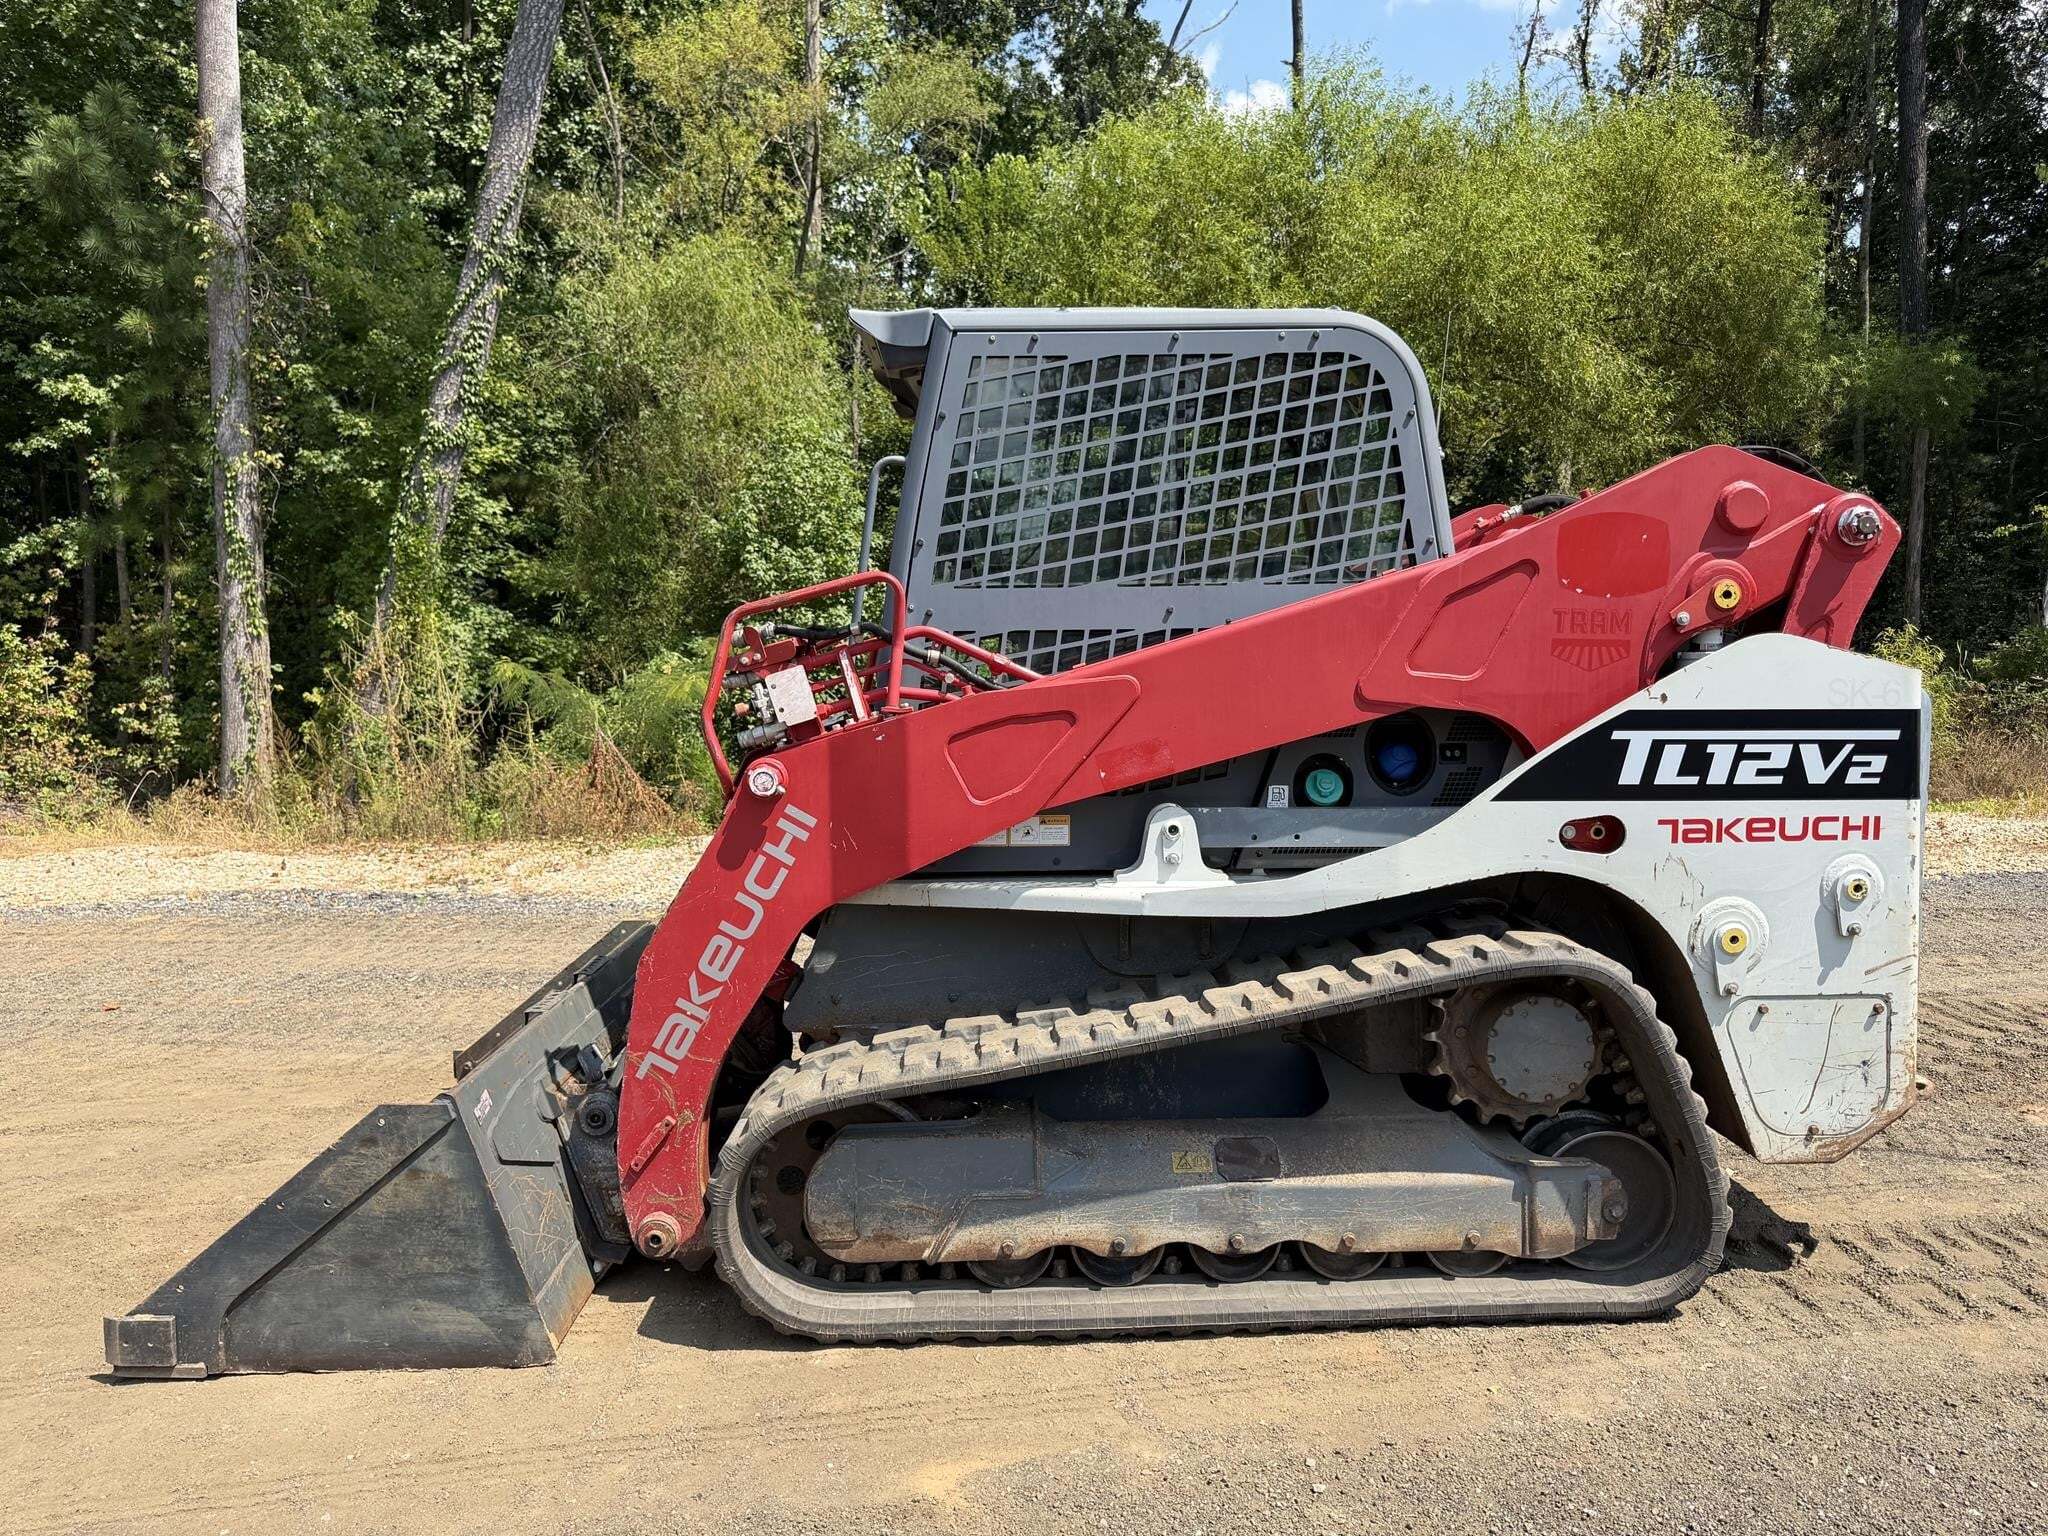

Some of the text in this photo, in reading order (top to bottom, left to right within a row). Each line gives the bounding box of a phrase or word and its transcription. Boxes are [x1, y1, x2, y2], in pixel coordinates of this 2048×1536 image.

[1552, 608, 1632, 634] TRAM
[1828, 678, 1901, 706] SK-6
[1610, 730, 1900, 785] TL12V2
